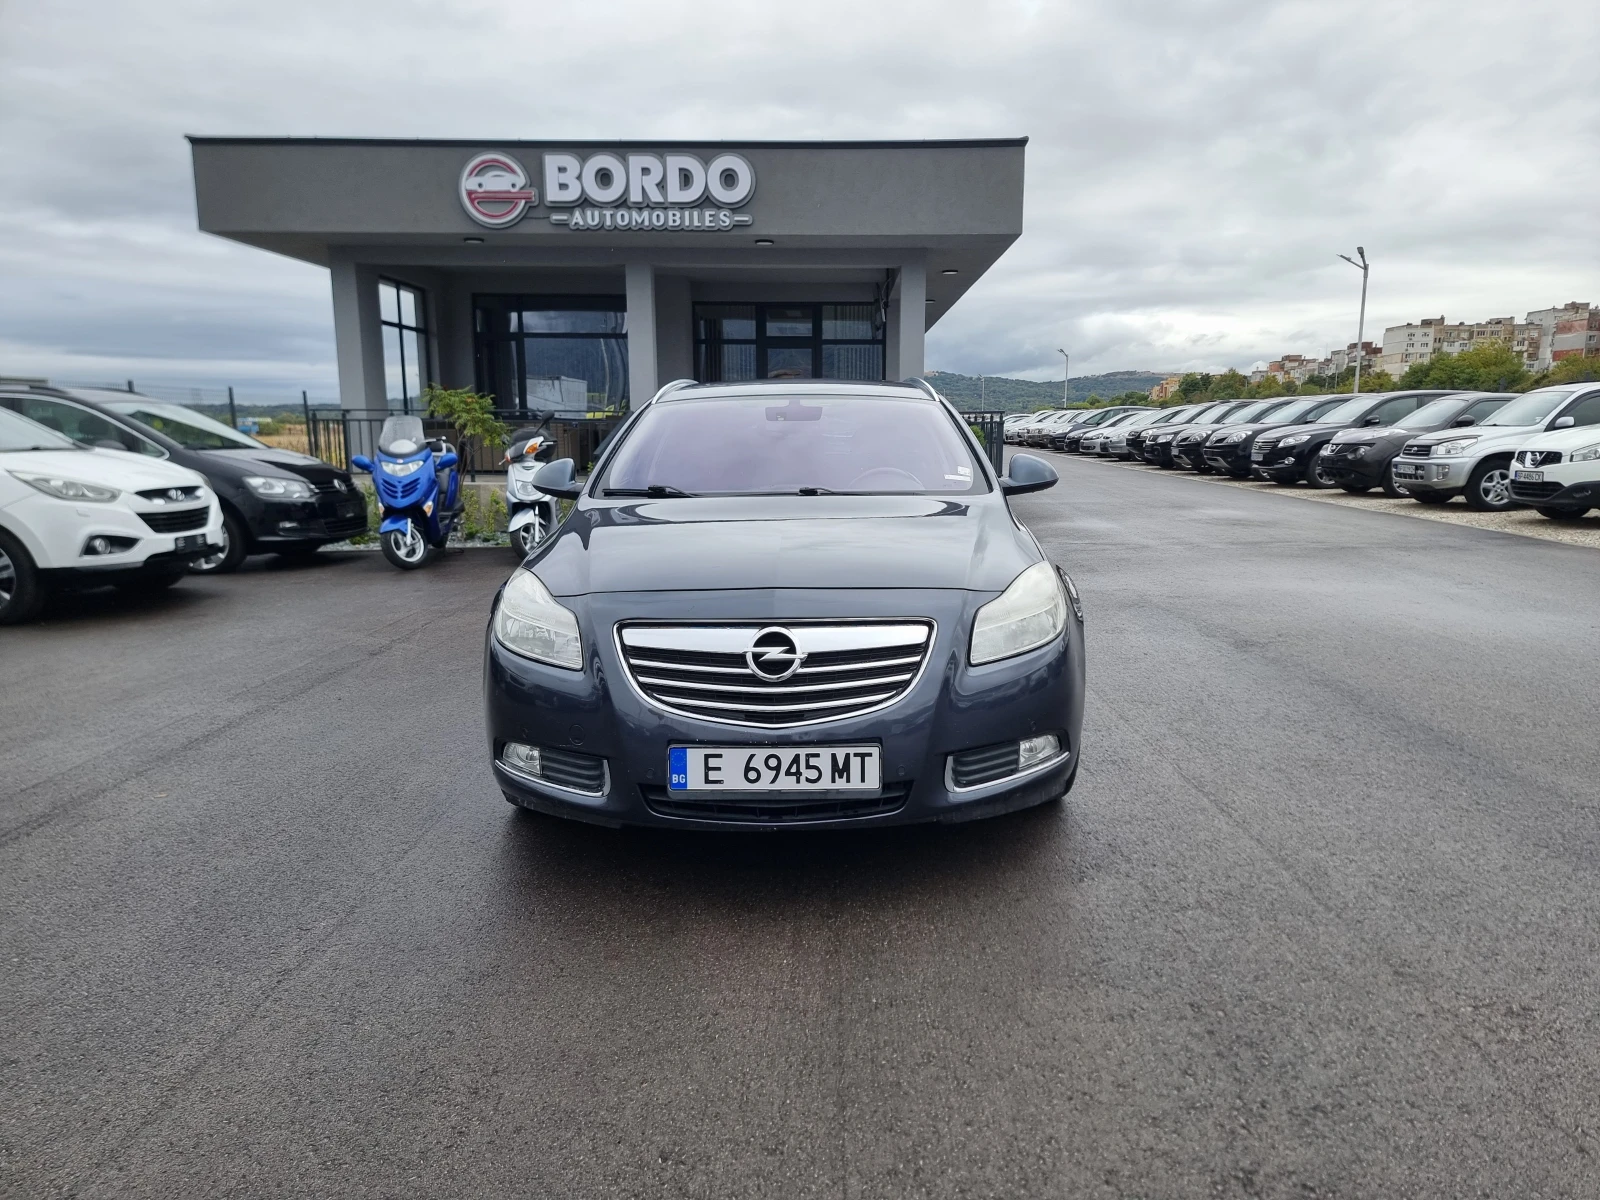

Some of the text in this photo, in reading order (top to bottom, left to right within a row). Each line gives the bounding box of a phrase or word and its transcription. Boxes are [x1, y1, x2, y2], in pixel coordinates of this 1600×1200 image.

[544, 154, 751, 203] BORDO
[571, 208, 731, 227] AUTOMOBILES
[672, 774, 686, 784] BG
[703, 753, 724, 784] E
